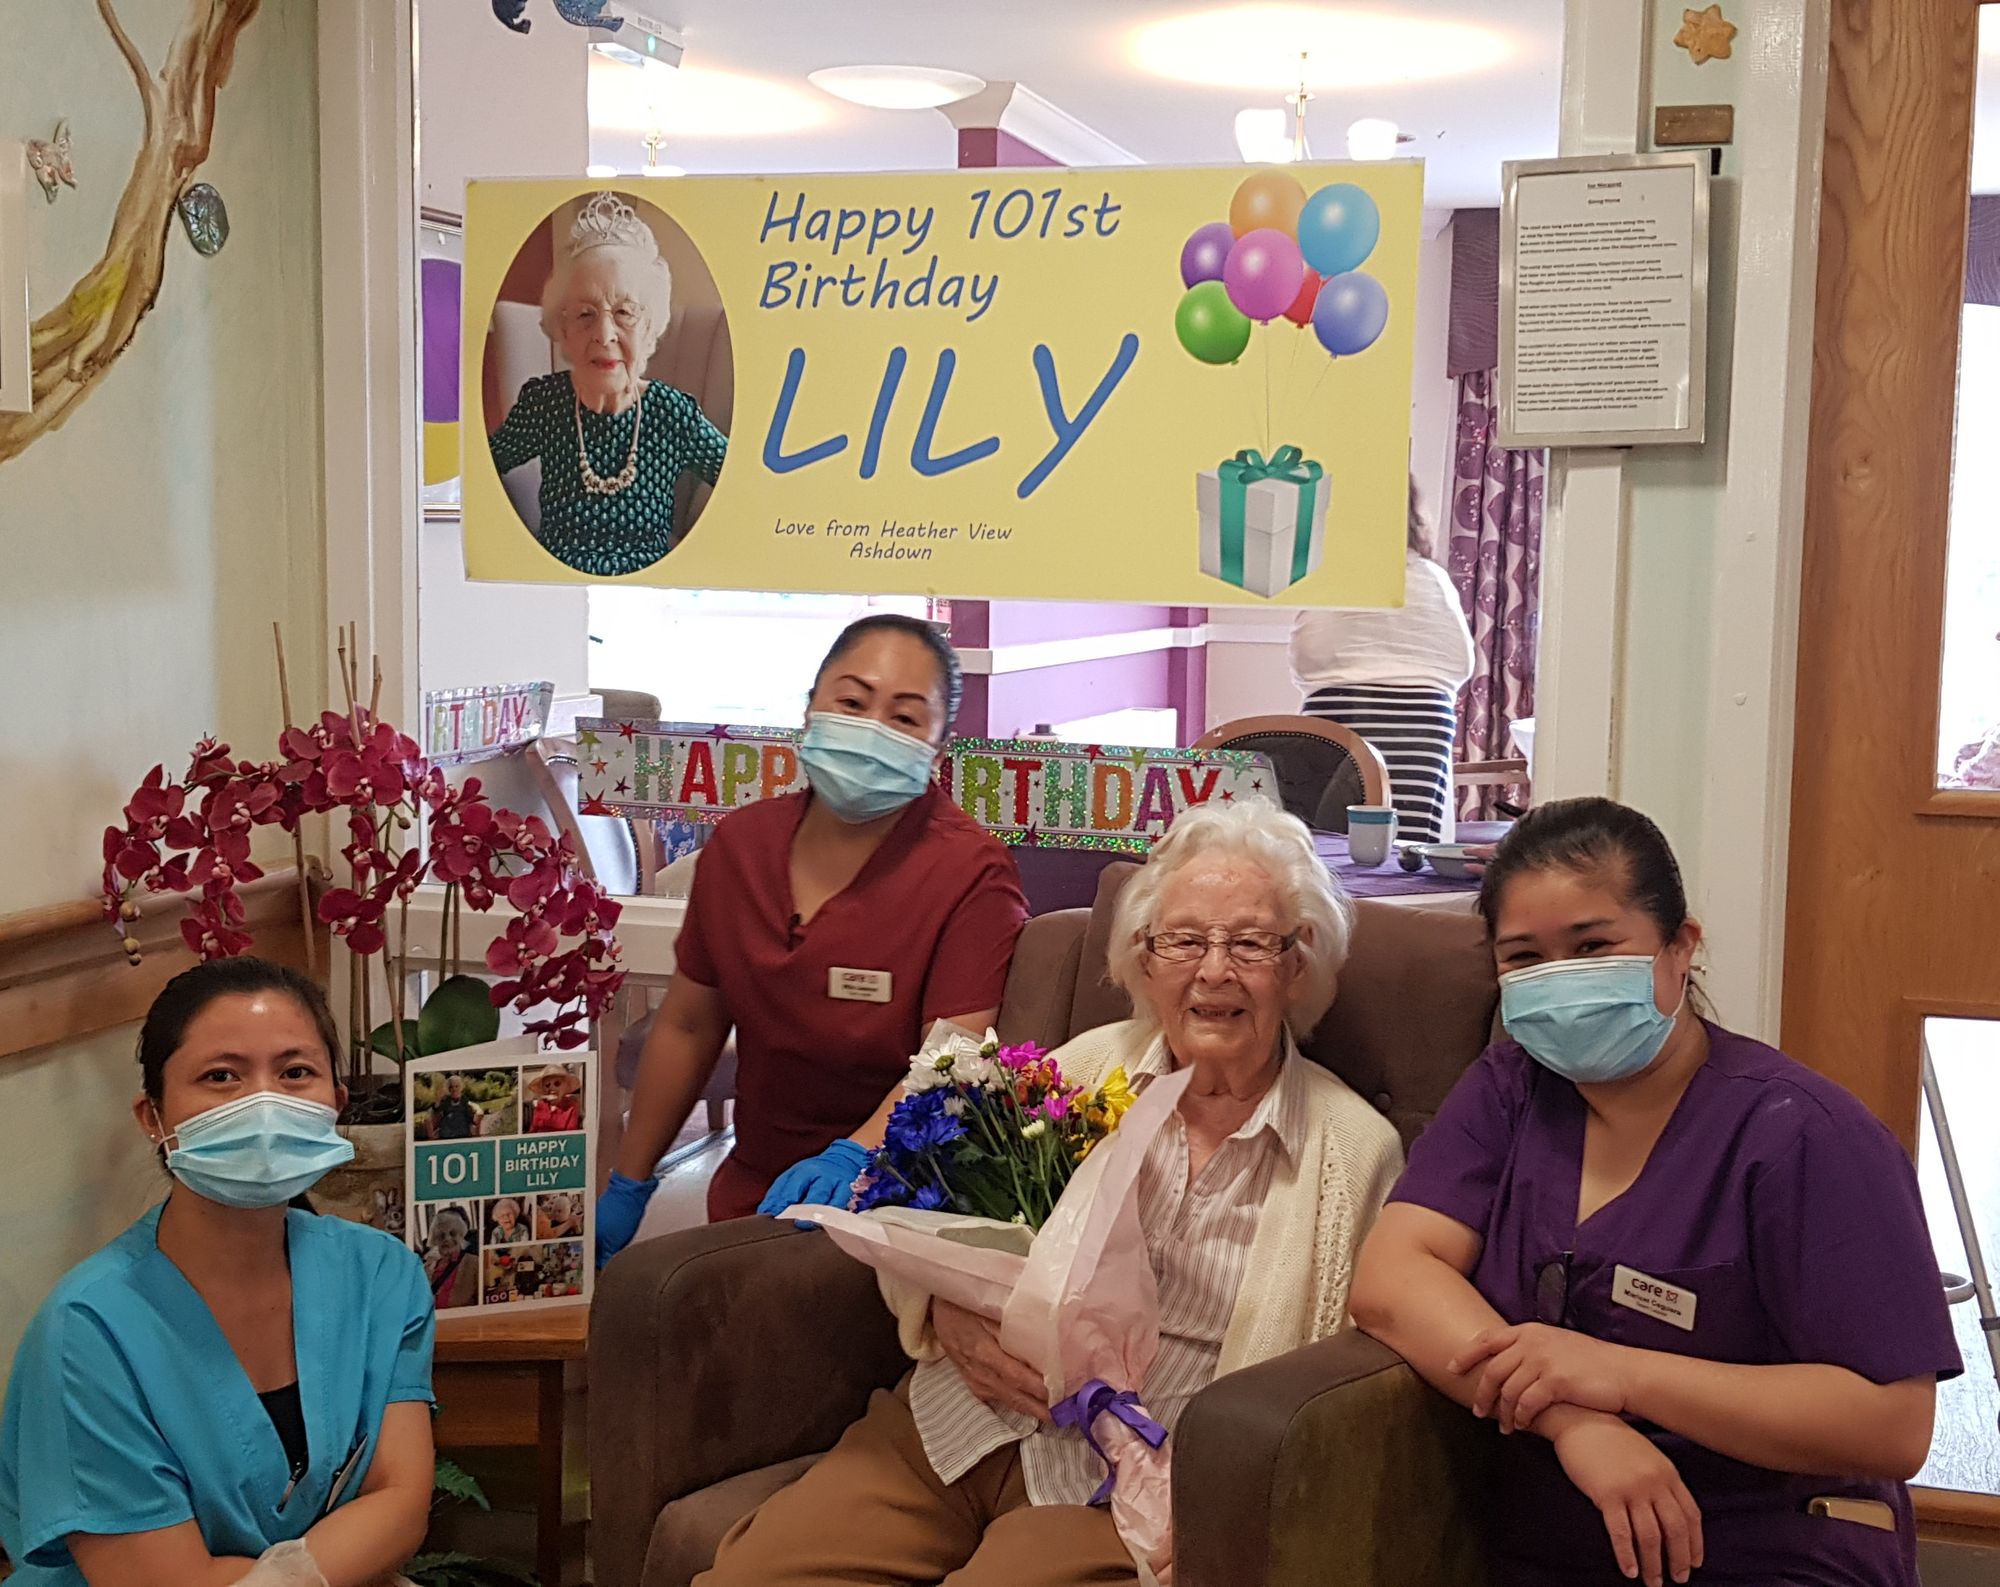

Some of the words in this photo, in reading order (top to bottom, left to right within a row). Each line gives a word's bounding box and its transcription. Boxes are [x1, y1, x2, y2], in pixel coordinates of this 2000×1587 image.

[760, 190, 934, 255] Happy
[969, 188, 1122, 239] 101st
[759, 256, 999, 322] Birthday
[762, 333, 1140, 499] LILY
[775, 518, 816, 537] Love
[826, 519, 871, 538] from
[881, 520, 958, 541] Heather
[968, 523, 1013, 541] View
[849, 541, 933, 560] Ashdown
[633, 735, 798, 807] HAPP
[517, 1139, 568, 1155] HAPPY
[427, 1151, 479, 1185] 101
[505, 1155, 580, 1172] BIRTHDAY
[526, 1172, 559, 1186] LILY
[1631, 1278, 1663, 1297] care
